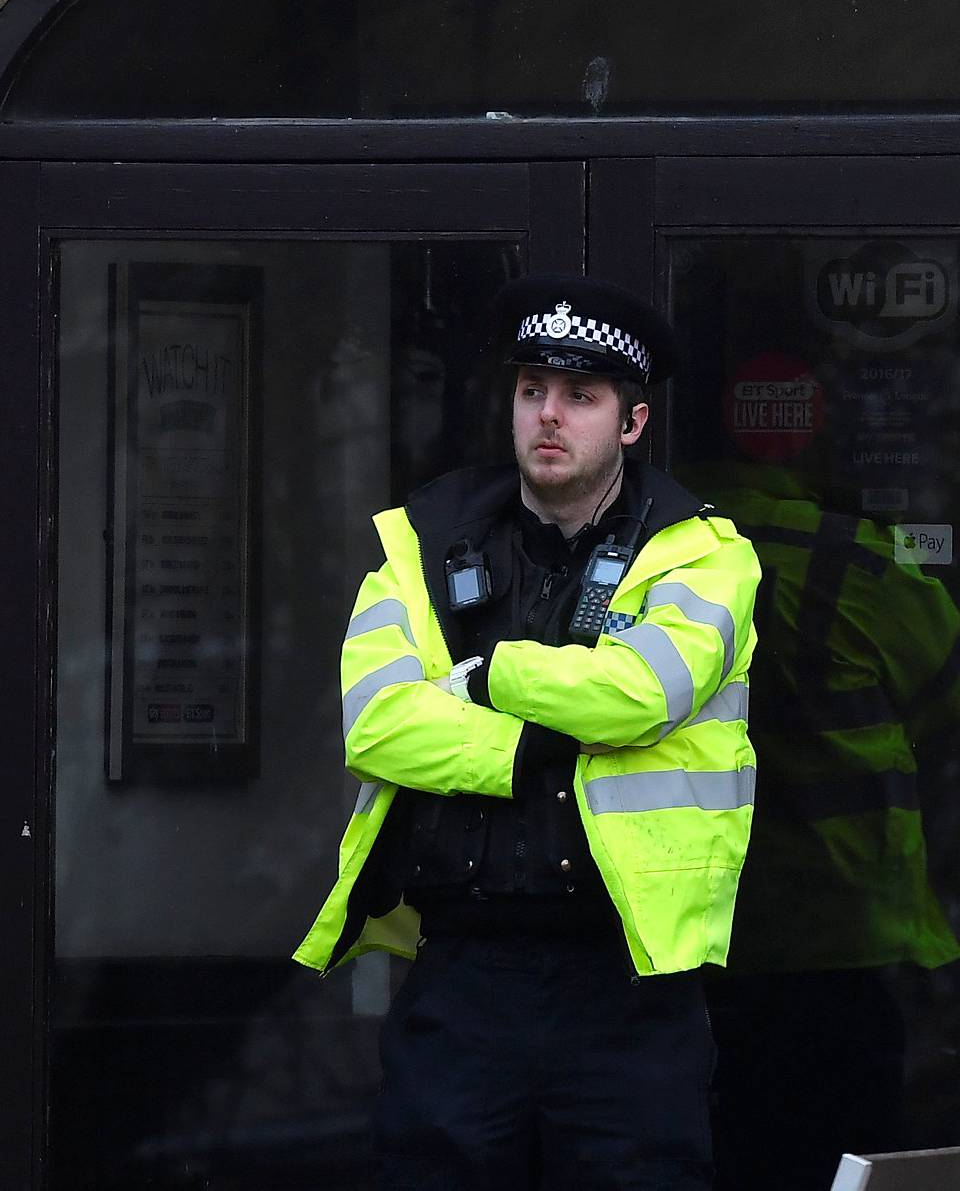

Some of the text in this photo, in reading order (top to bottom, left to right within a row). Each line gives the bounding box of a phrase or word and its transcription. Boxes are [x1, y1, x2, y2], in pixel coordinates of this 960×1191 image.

[828, 271, 935, 306] WiFi
[733, 402, 814, 427] LIVE HERE
[852, 451, 920, 465] LIVE HERE
[919, 533, 945, 554] Pay
